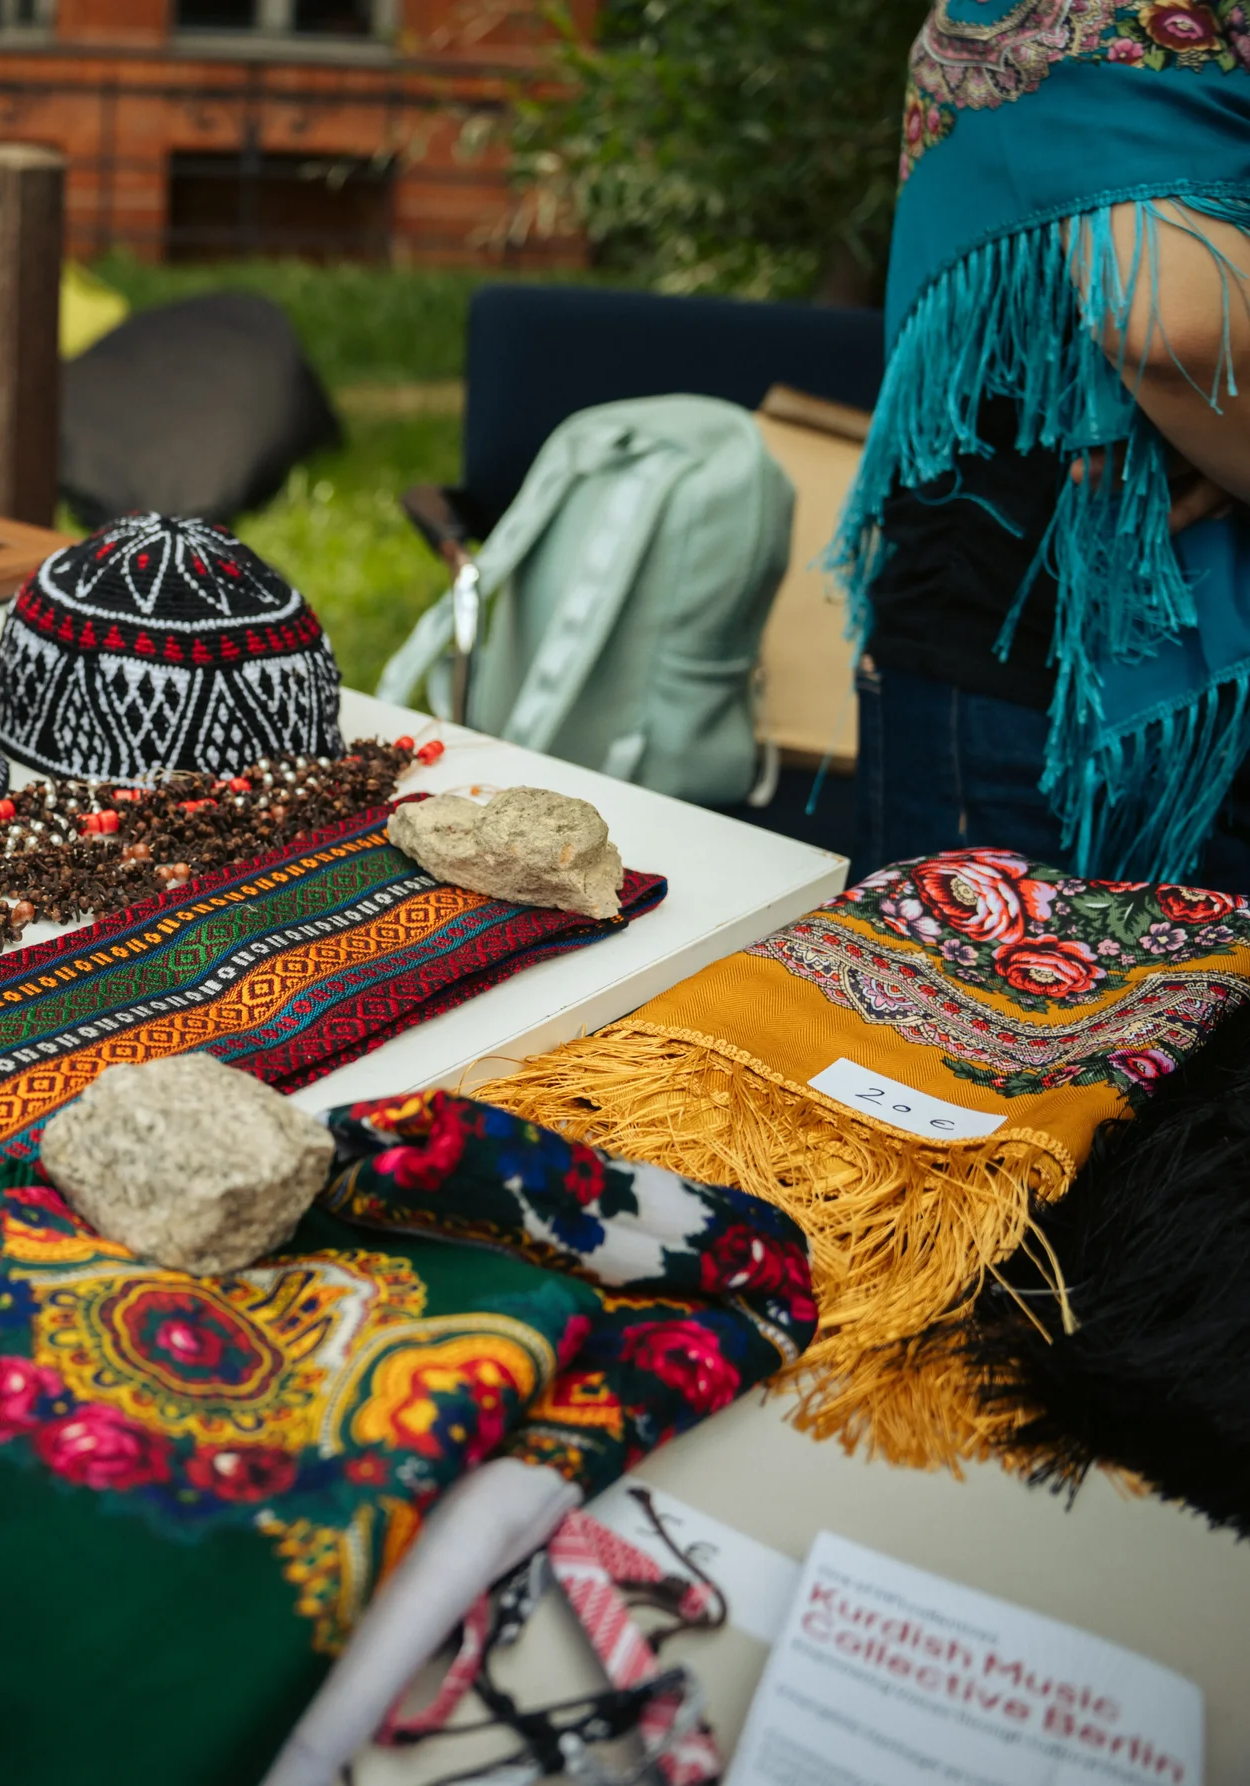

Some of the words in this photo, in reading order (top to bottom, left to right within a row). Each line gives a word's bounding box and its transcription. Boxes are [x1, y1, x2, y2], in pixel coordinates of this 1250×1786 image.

[855, 1087, 912, 1113] 20
[929, 1118, 956, 1131] €
[800, 1608, 1032, 1722] Collective
[1042, 1703, 1186, 1786] Berlin
[809, 1580, 974, 1669] Kurdish
[982, 1652, 1120, 1724] Music
